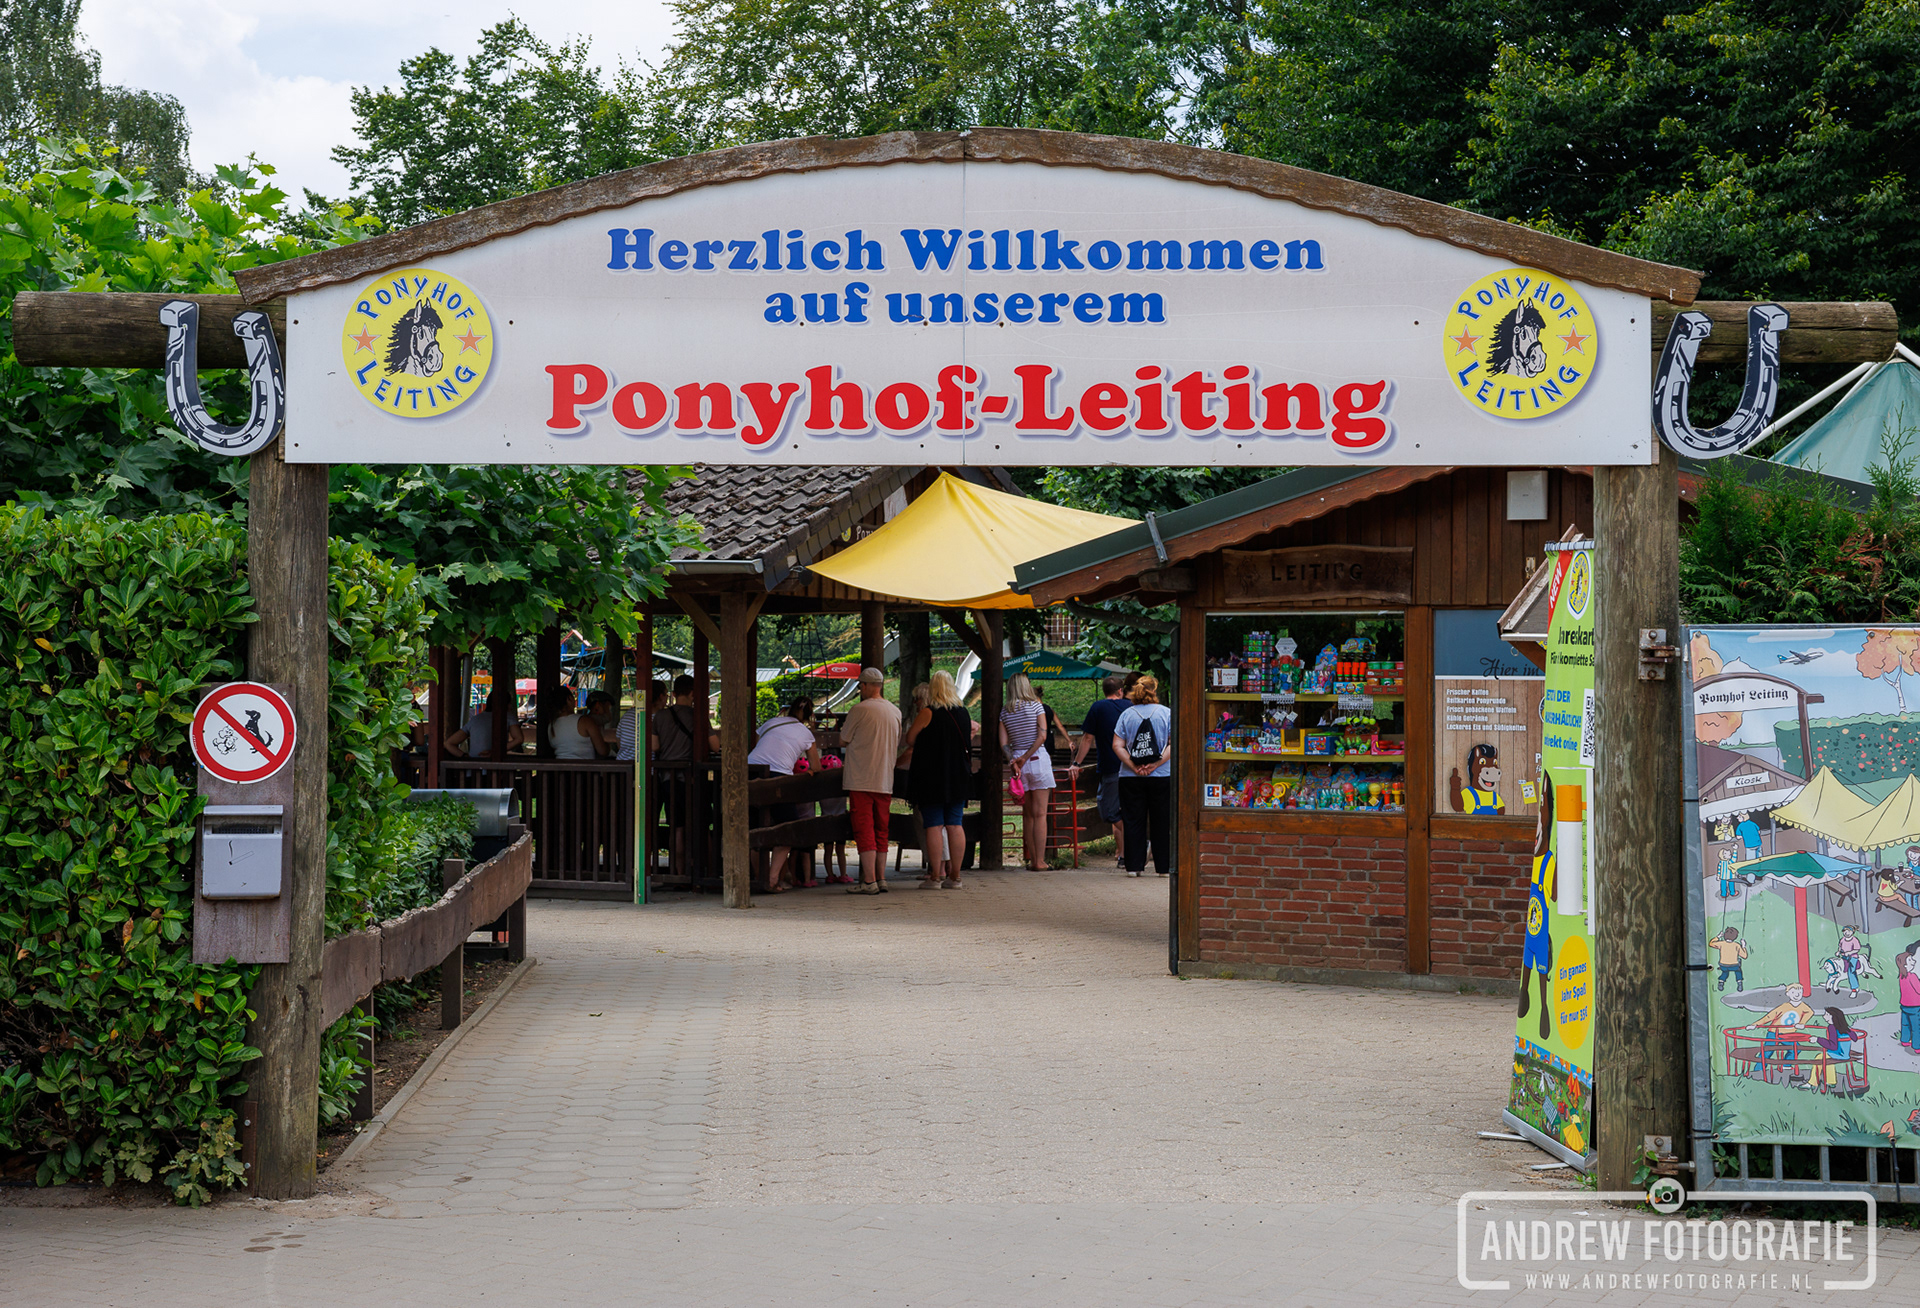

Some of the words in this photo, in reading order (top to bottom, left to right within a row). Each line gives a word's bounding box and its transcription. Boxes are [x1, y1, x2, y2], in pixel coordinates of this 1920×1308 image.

[606, 228, 885, 271] Herzlich
[899, 228, 1324, 271] Willkommen
[355, 275, 476, 320] PONYHOF
[763, 281, 870, 323] auf
[884, 292, 1166, 324] unserem
[1456, 275, 1579, 321] PONYHOF
[355, 359, 478, 411] LEITING
[1456, 360, 1582, 412] LEITING
[544, 363, 1387, 448] Ponyhof-Leiting
[1549, 561, 1563, 609] NEW
[1022, 661, 1063, 676] Tommy
[1480, 657, 1518, 680] Hier
[1446, 688, 1471, 696] Frischer
[1471, 688, 1489, 696] Kaffee
[1556, 689, 1571, 703] DER
[1699, 691, 1745, 706] Ponyhof
[1749, 689, 1789, 701] Leiting
[1495, 706, 1517, 714] Waffeln
[1446, 723, 1472, 731] Leckeres
[1472, 723, 1481, 731] Eis
[1482, 723, 1493, 731] und
[1734, 775, 1763, 786] Kiosk
[1573, 982, 1587, 1001] Spaß
